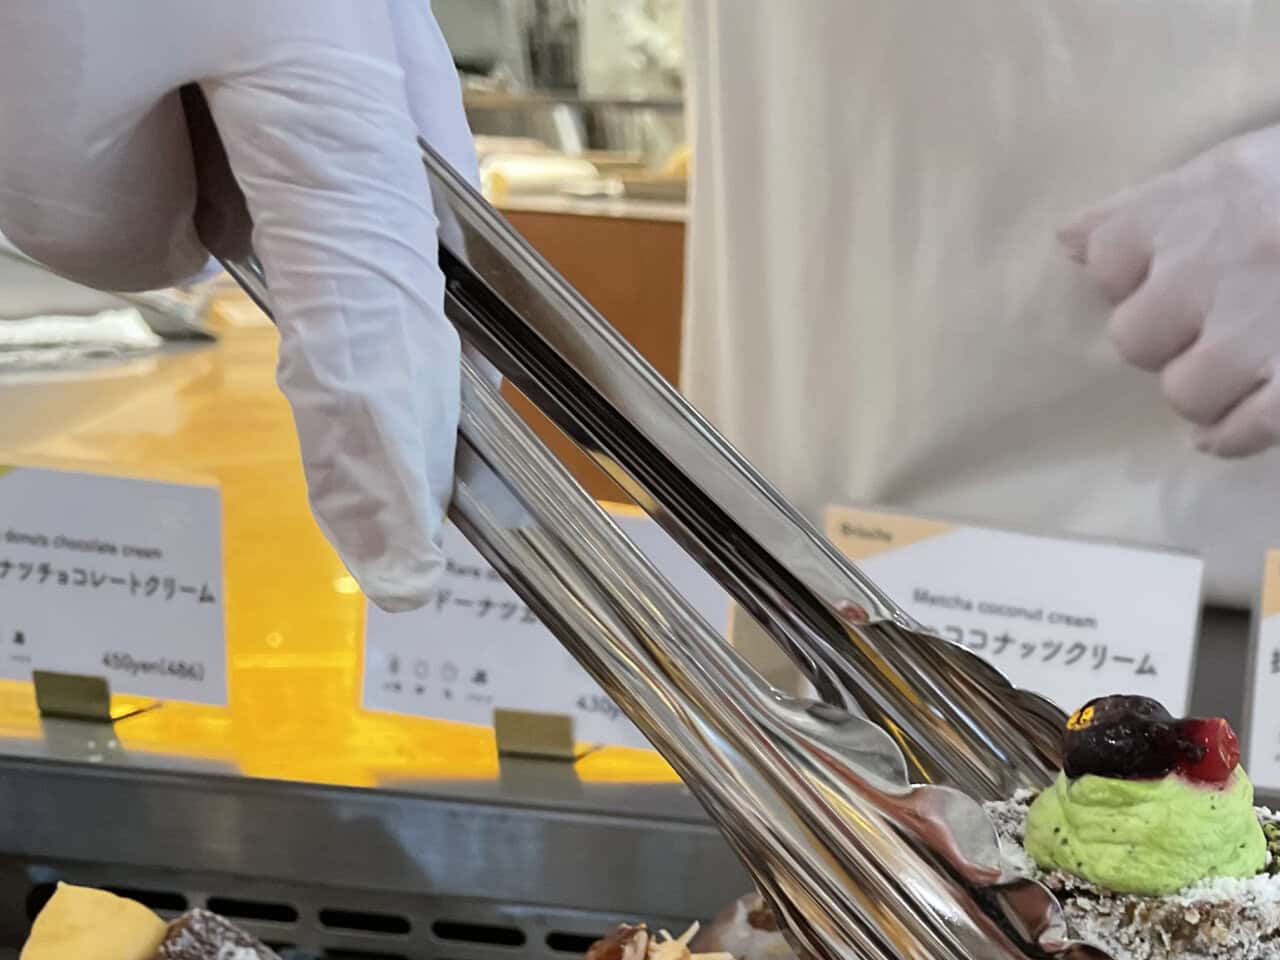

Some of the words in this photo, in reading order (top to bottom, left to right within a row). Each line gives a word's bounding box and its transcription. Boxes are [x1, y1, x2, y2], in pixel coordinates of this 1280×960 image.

[976, 600, 1045, 622] coconut
[925, 622, 1157, 675] ココナッツクリーム
